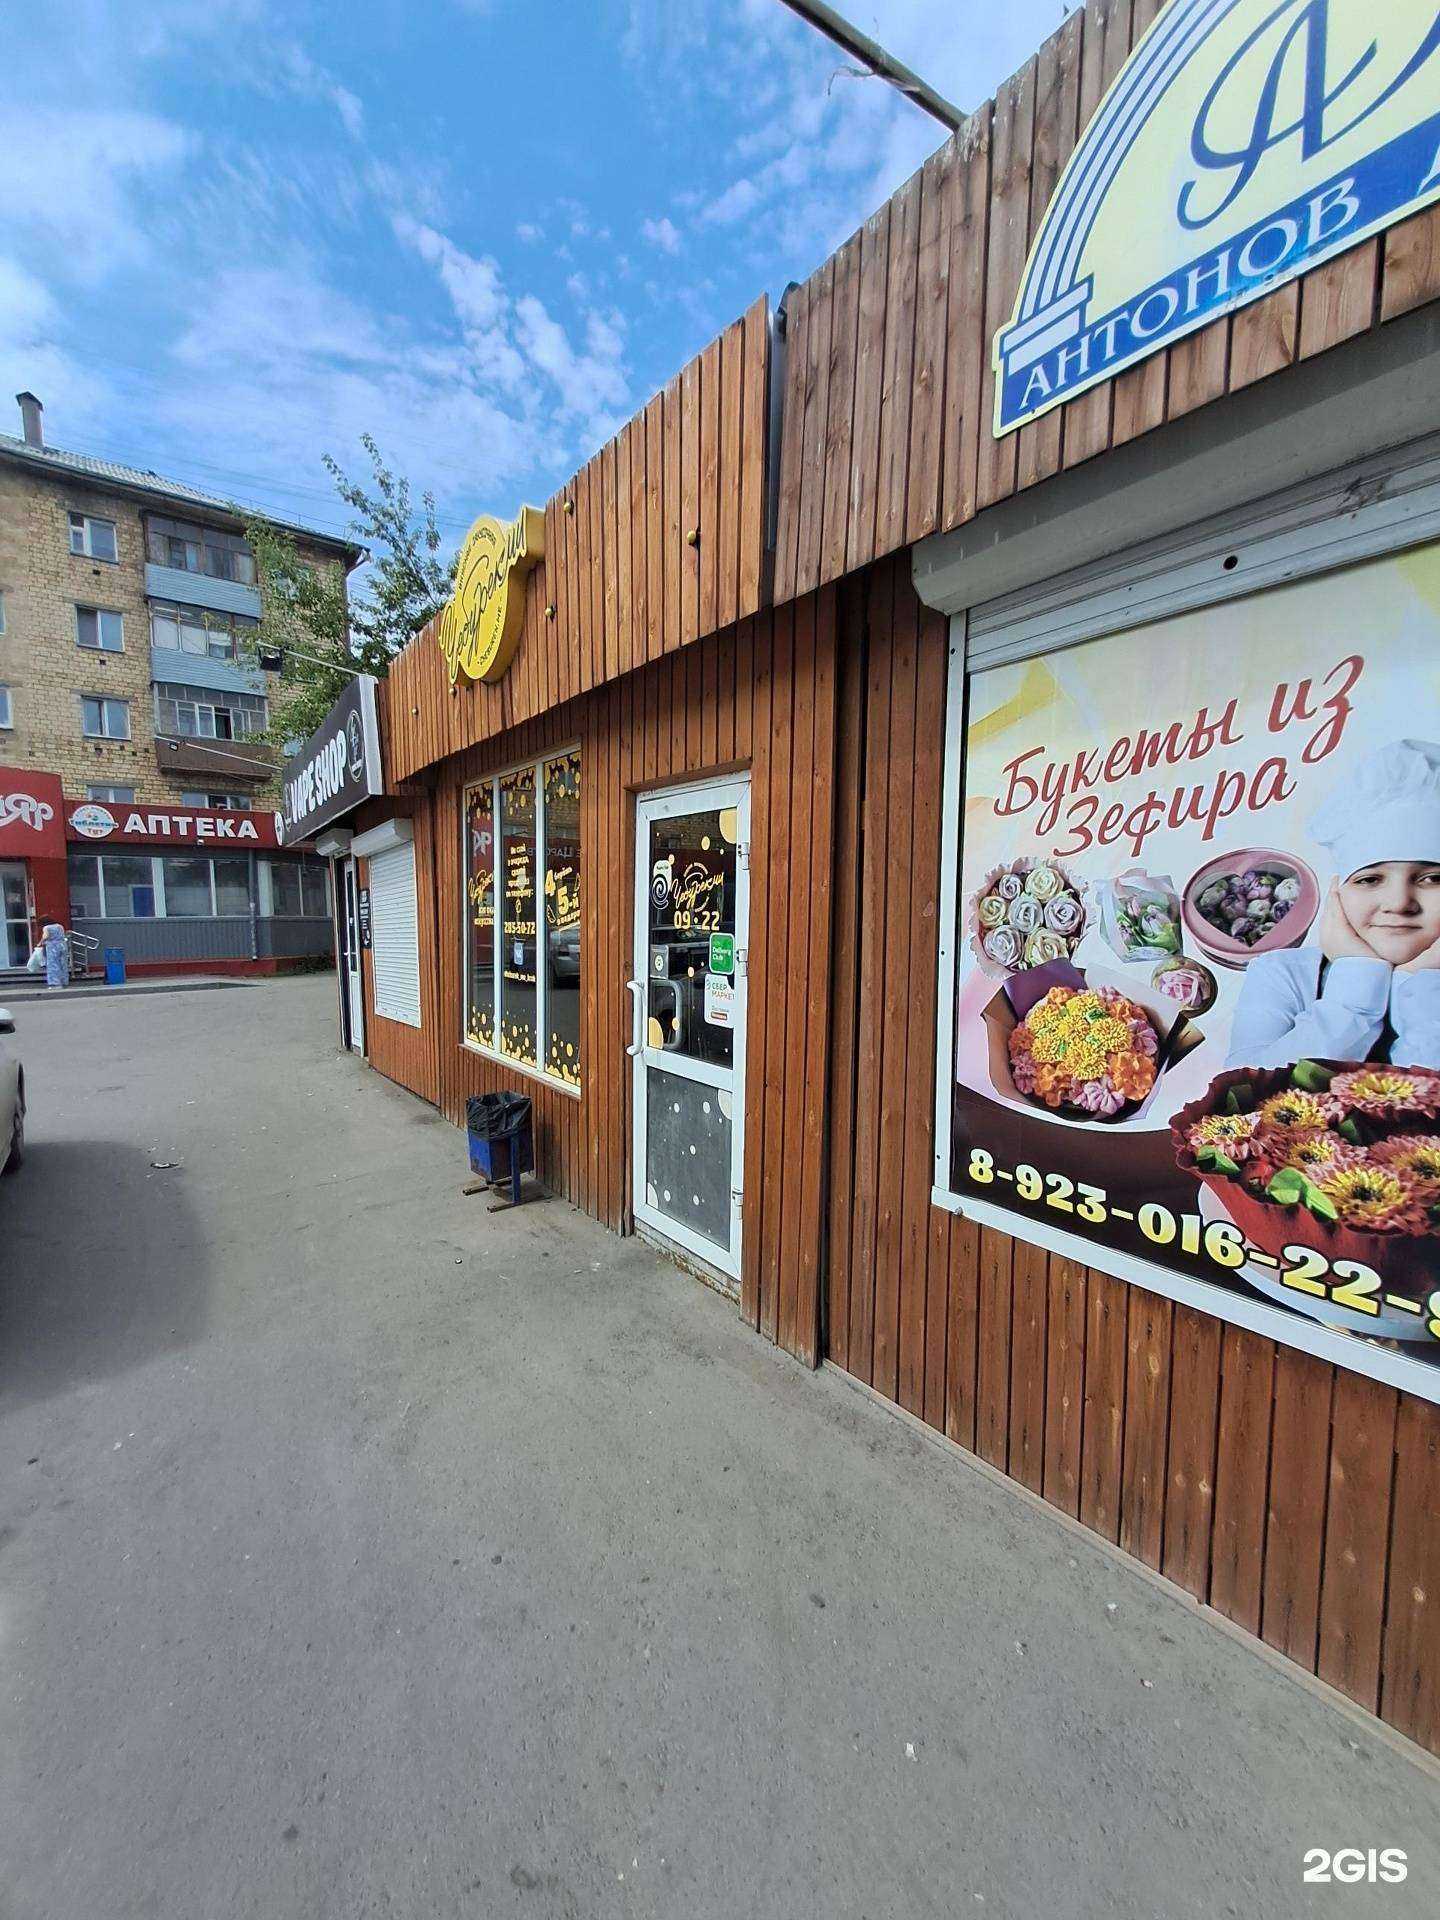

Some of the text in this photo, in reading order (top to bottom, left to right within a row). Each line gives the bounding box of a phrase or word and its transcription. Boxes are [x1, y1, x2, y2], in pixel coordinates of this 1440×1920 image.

[1018, 177, 1360, 411] АНТОНОВ
[314, 729, 347, 806] SHOP
[993, 654, 1366, 837] Букеты из
[123, 813, 259, 839] АПТЕКА
[1053, 756, 1298, 858] Зефира
[674, 910, 720, 931] 09 22
